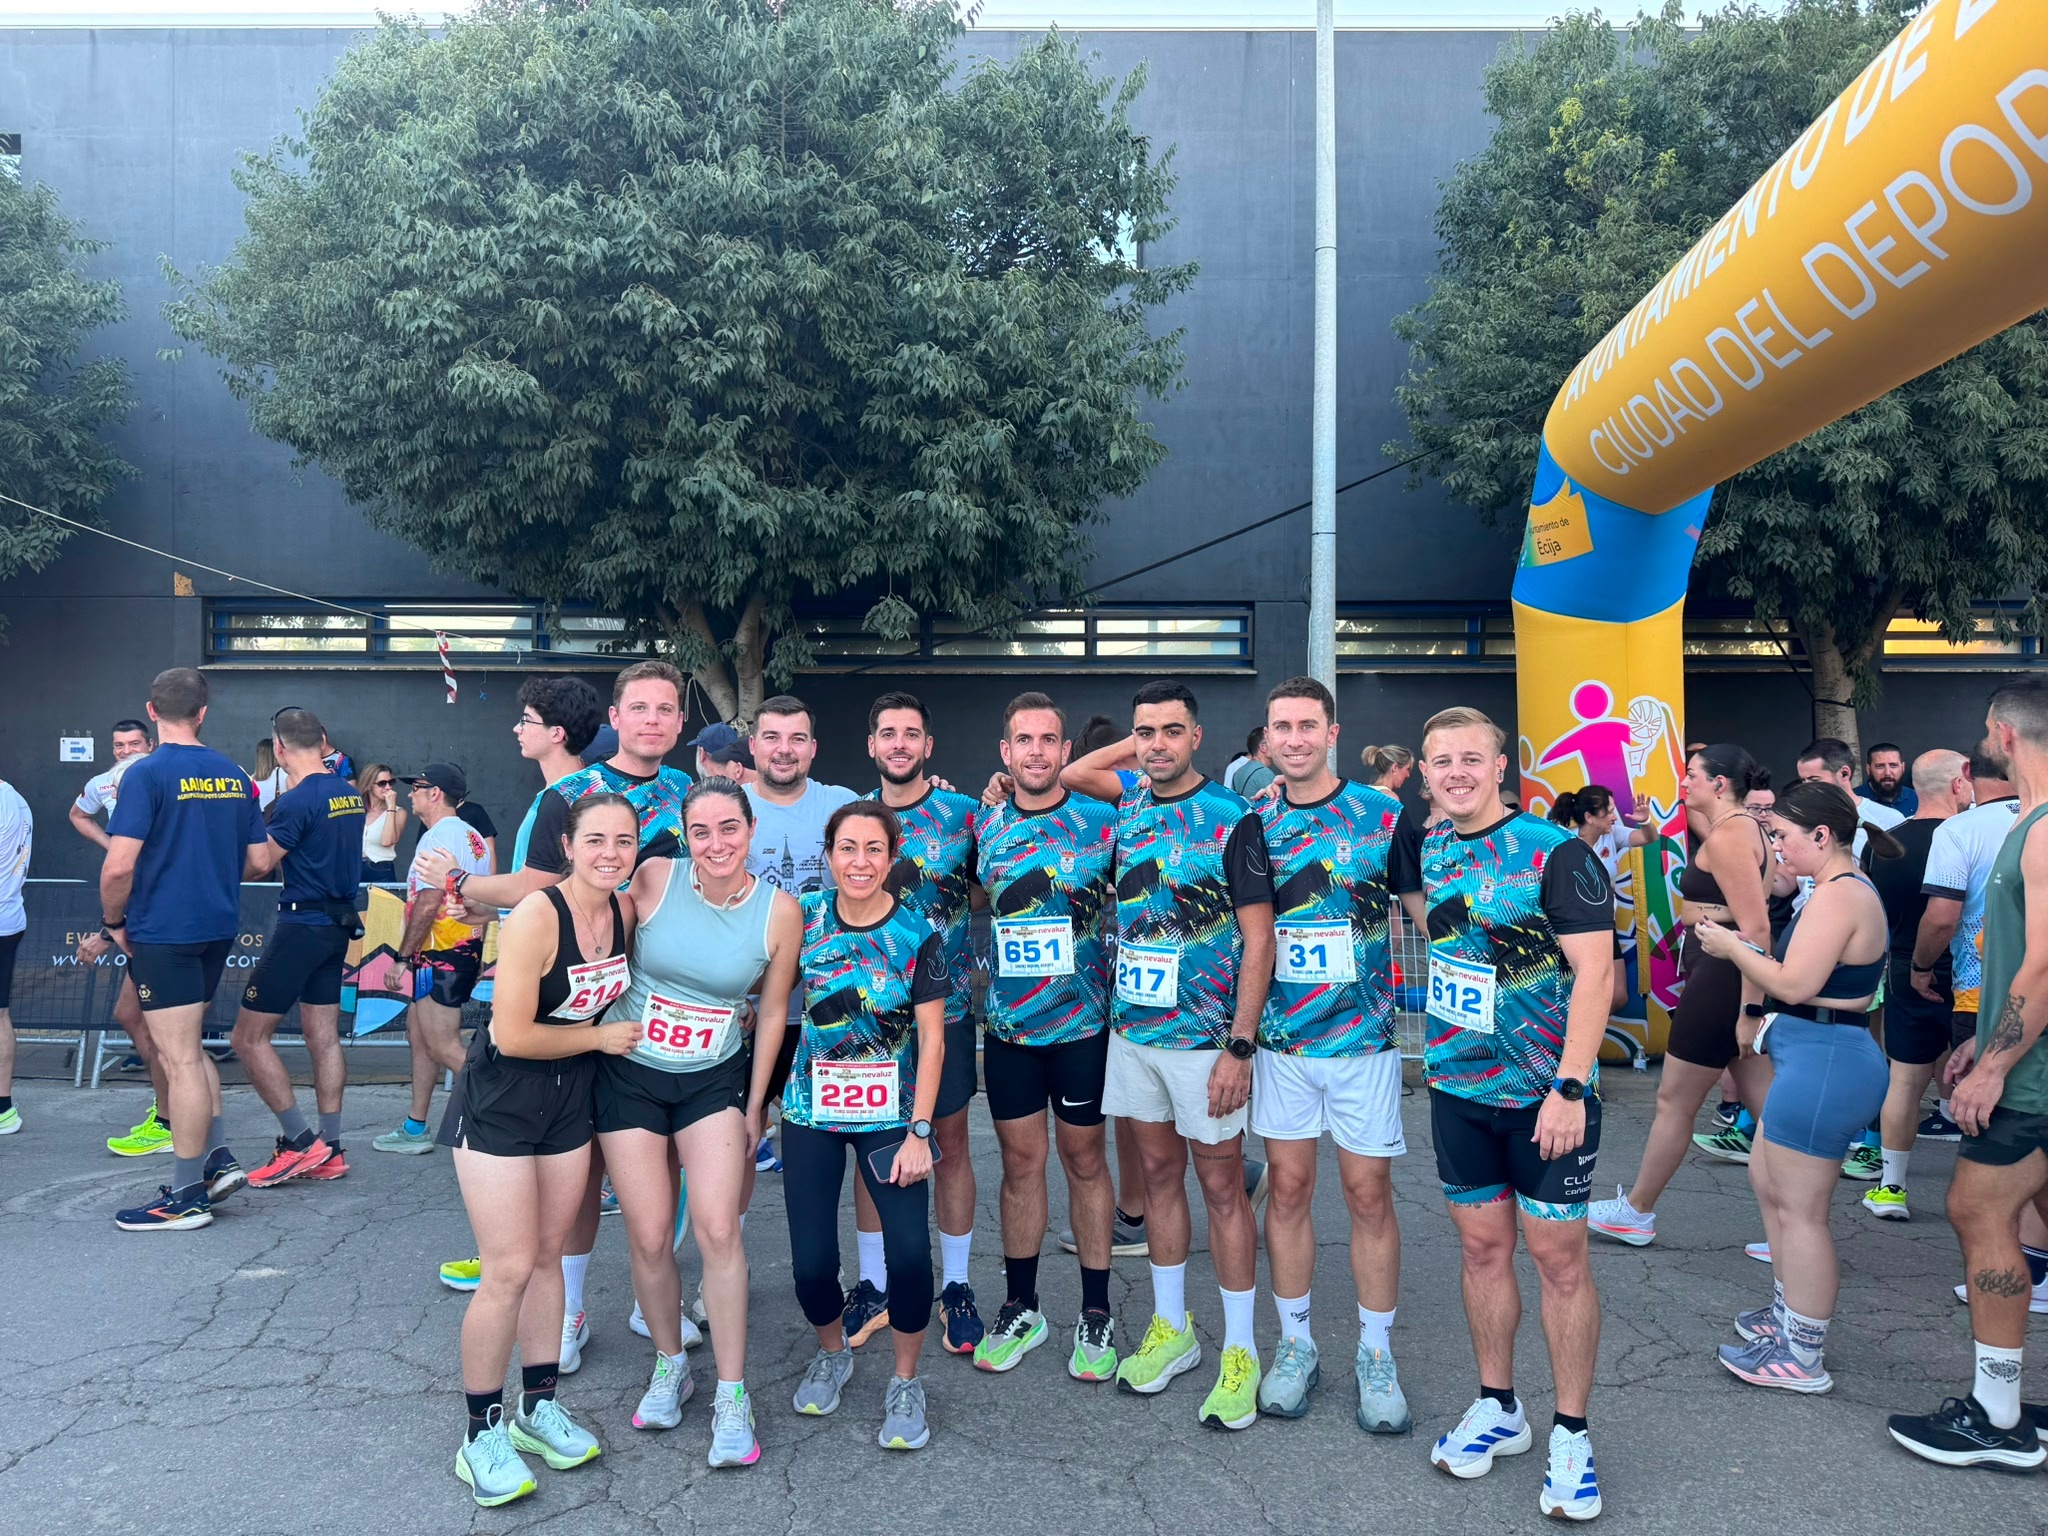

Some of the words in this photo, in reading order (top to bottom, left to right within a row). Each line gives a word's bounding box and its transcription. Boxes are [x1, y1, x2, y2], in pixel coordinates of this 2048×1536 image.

[1843, 0, 1942, 148] DE
[1589, 357, 1724, 476] CIUDAD
[1704, 288, 1833, 391] DEL
[1559, 517, 1570, 527] de
[1537, 538, 1562, 556] Écija
[1038, 926, 1067, 934] nevaluz
[1314, 930, 1346, 938] nevaluz
[1004, 938, 1060, 963] 651
[1143, 955, 1173, 964] nevaluz
[1289, 944, 1327, 968] 31
[1118, 962, 1166, 992] 217
[1458, 971, 1489, 984] nevaluz
[568, 980, 623, 1008] 614
[1432, 975, 1482, 1015] 612
[694, 1014, 726, 1024] nevaluz
[647, 1018, 714, 1049] 681
[861, 1070, 892, 1079] nevaluz
[820, 1083, 888, 1108] 220
